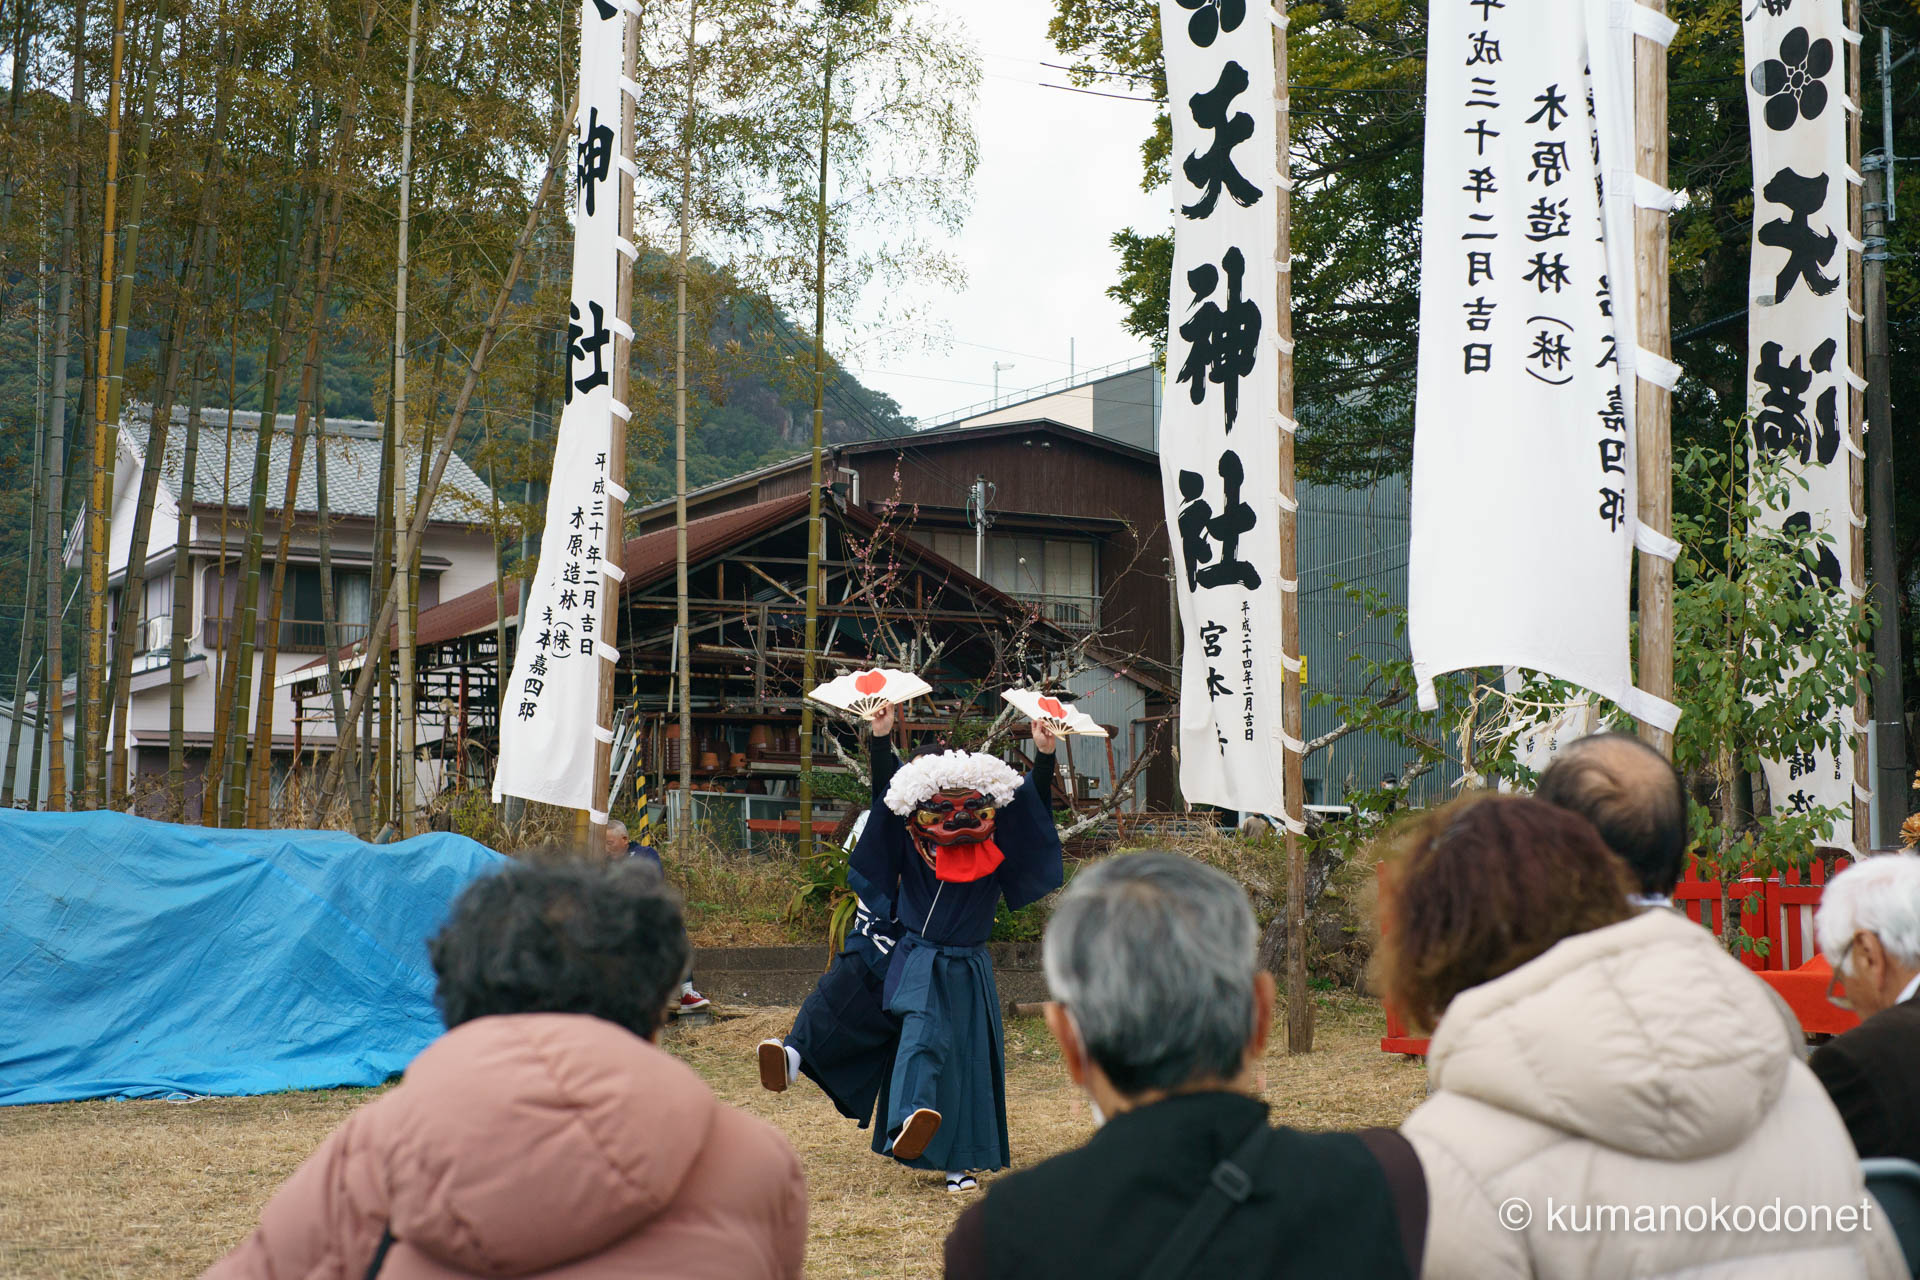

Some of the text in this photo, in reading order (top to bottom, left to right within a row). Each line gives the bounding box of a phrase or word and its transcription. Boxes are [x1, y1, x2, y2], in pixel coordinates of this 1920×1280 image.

[565, 0, 618, 405] 神社
[1176, 60, 1264, 593] 天神社
[579, 453, 606, 657] 平成三十年二月吉日
[1241, 601, 1254, 741] 平成二十四年二月吉日
